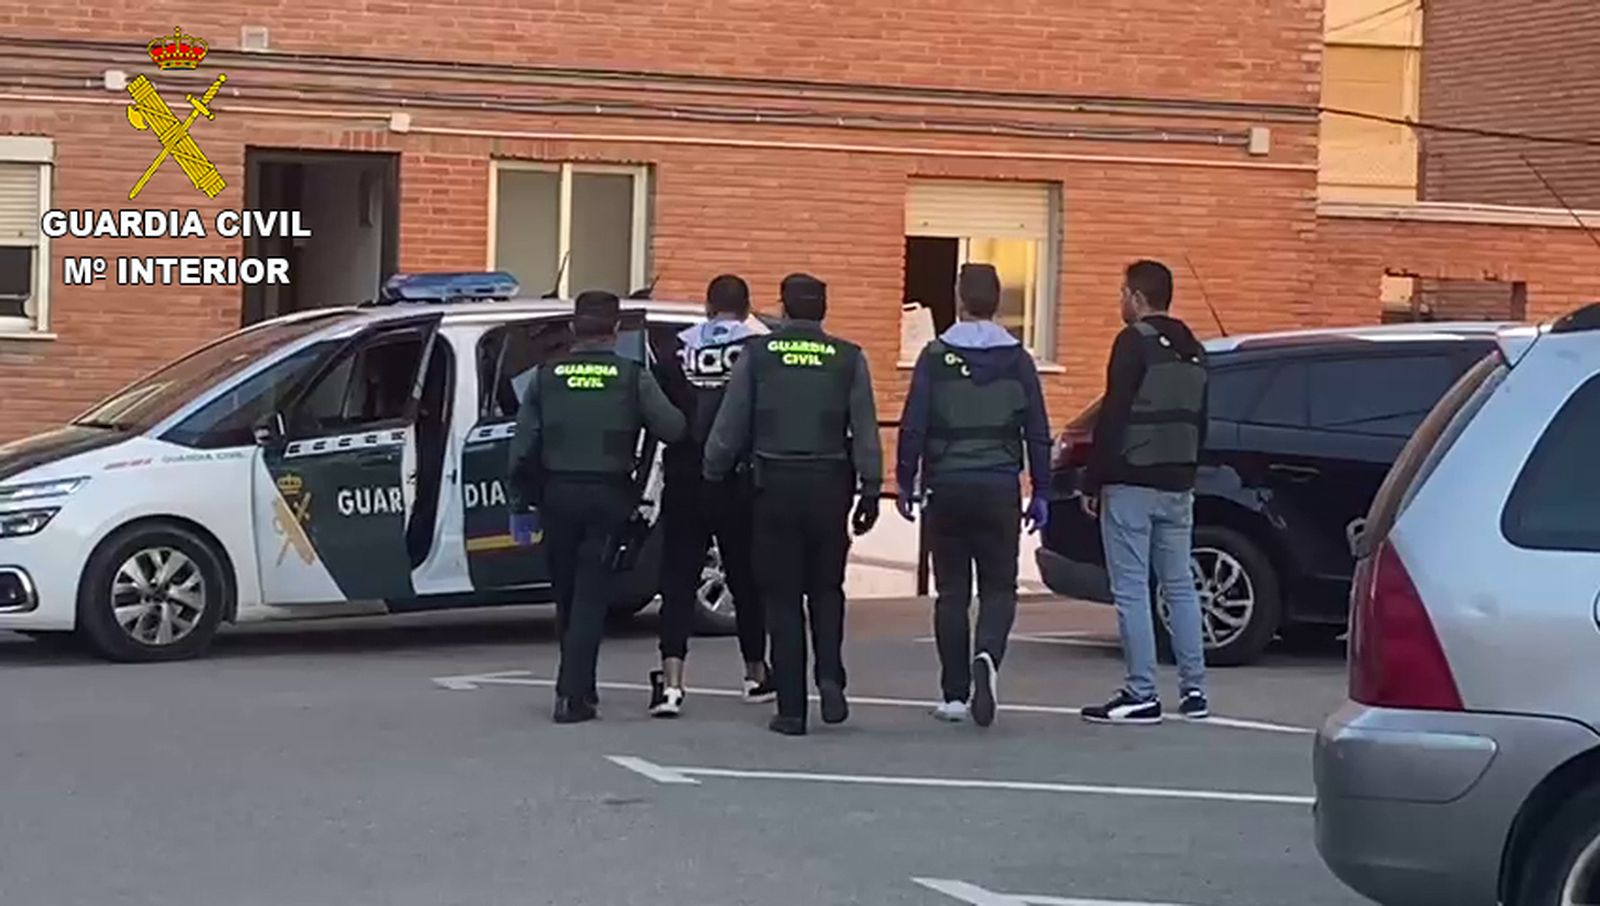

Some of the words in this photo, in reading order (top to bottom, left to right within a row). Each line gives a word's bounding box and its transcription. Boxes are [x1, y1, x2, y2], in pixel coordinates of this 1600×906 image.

[767, 340, 836, 355] GUARDIA
[783, 353, 823, 366] CIVIL
[554, 364, 618, 376] GUARDIA
[567, 376, 604, 388] CIVIL
[337, 486, 404, 516] GUAR
[464, 481, 507, 509] DIA
